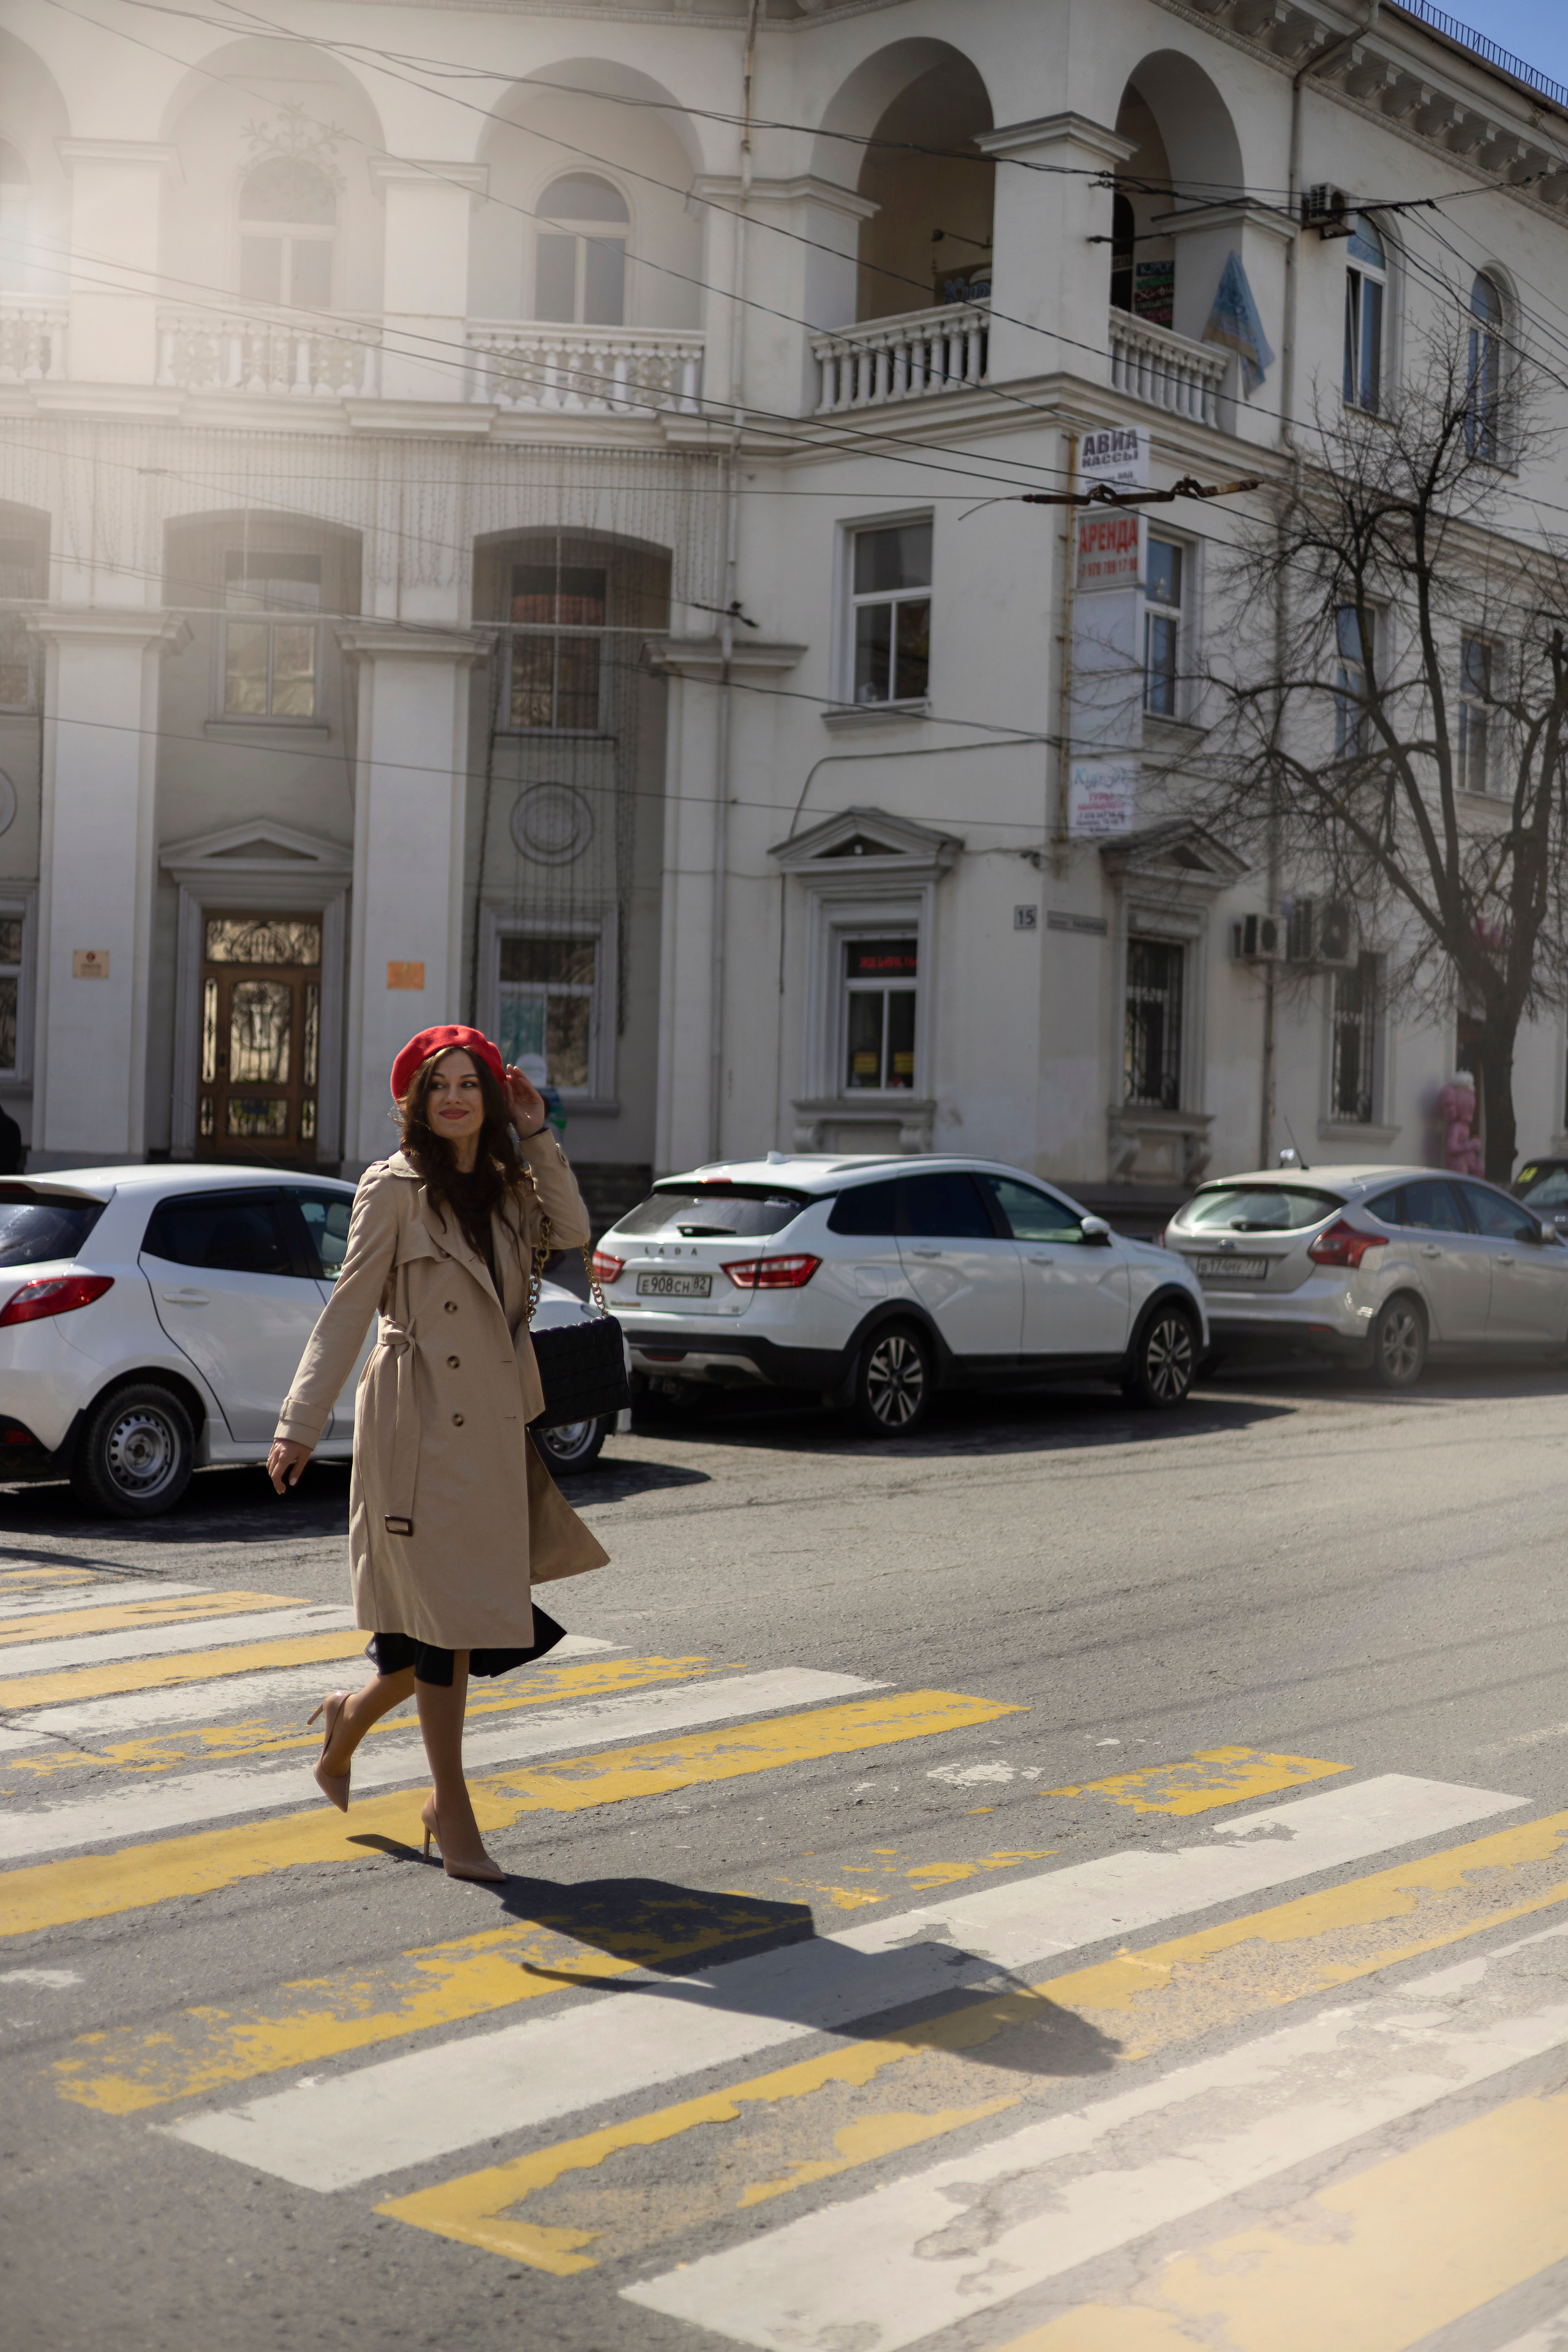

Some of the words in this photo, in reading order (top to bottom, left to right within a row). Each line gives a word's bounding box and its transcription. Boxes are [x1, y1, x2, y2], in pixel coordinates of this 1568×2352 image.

[1082, 429, 1137, 456] АВИА
[1082, 449, 1138, 467] КАССЫ
[1079, 518, 1137, 554] АРЕНДА
[1018, 909, 1035, 925] 15
[645, 1246, 698, 1256] LADA
